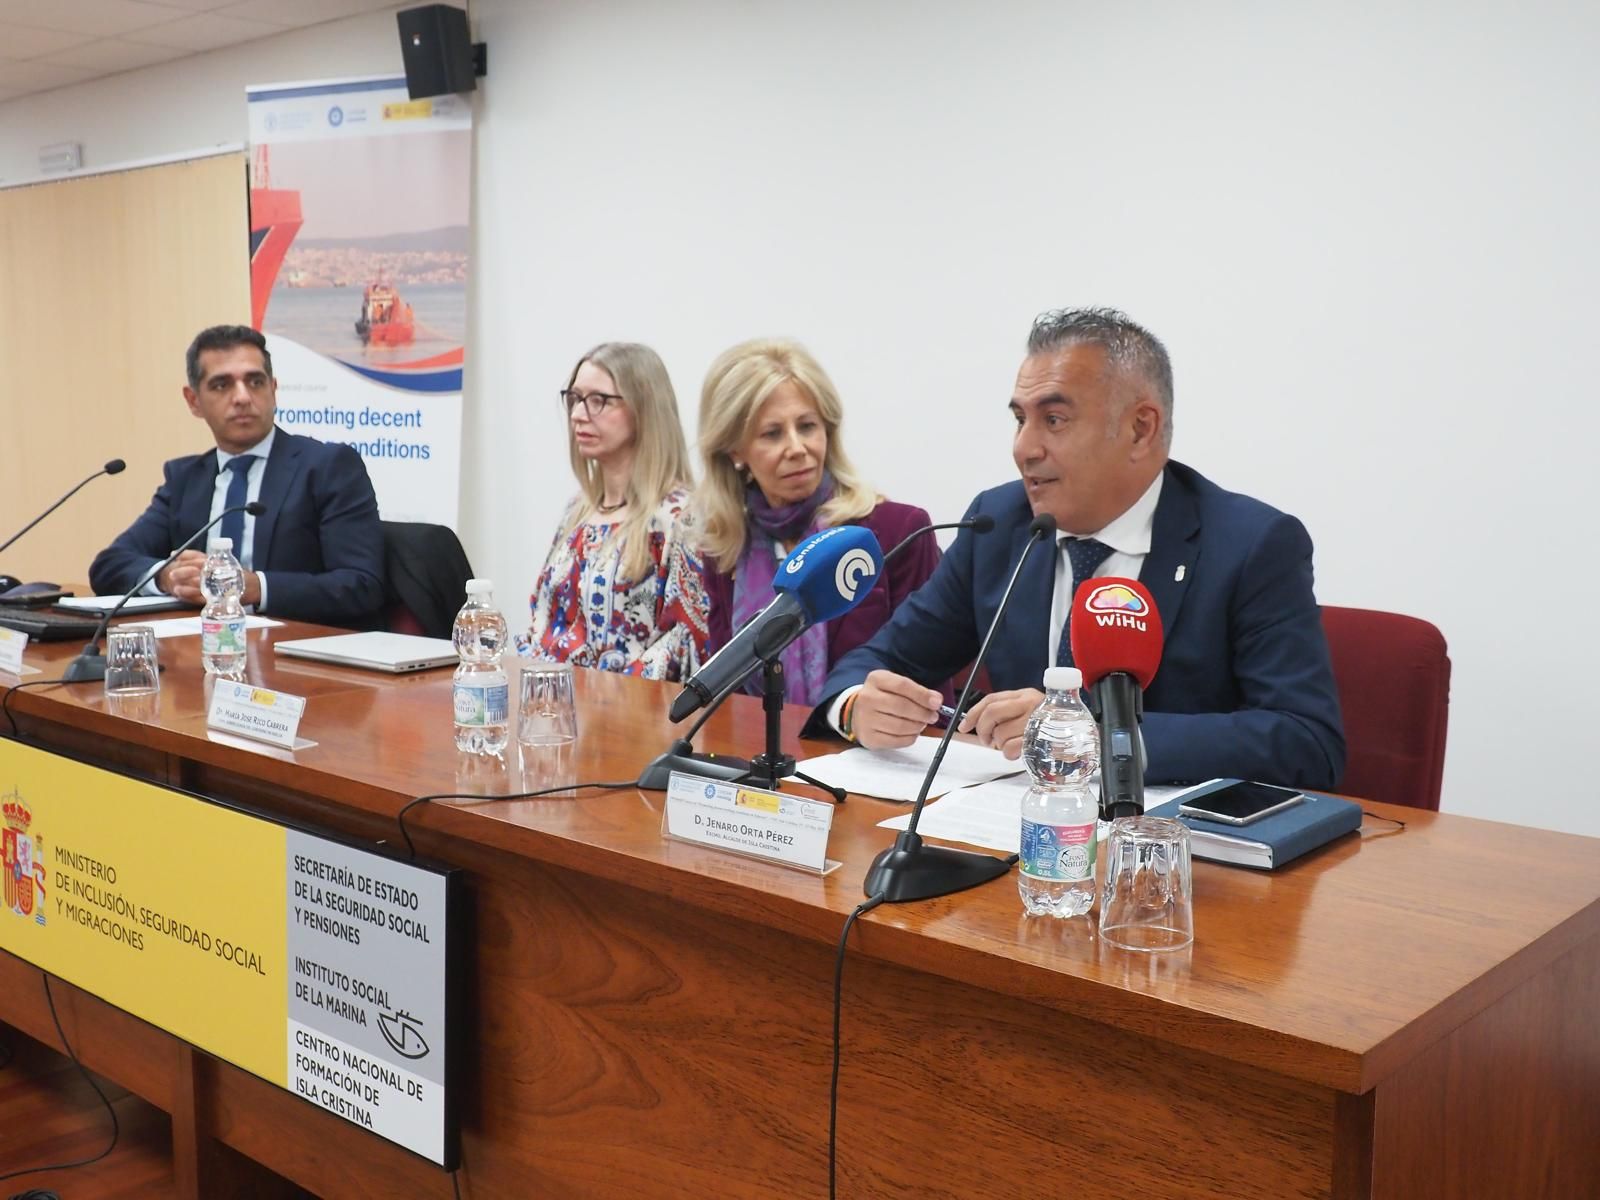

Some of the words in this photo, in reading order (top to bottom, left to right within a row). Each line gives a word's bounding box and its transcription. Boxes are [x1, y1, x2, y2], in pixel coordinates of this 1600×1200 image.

[358, 406, 422, 428] decent
[1095, 613, 1147, 632] WiHu
[267, 719, 289, 732] CABRERA
[694, 814, 704, 826] D.
[706, 816, 738, 833] JENARO
[740, 824, 764, 839] ORTA
[766, 829, 794, 846] PÉREZ
[55, 845, 117, 885] MINISTERIO
[294, 855, 355, 890] SECRETARÍA
[358, 874, 372, 895] DE
[375, 880, 419, 911] ESTADO
[1060, 859, 1088, 869] Natura
[55, 871, 71, 893] DE
[72, 878, 138, 924] INCLUSIÓN,
[139, 906, 212, 952] SEGURIDAD
[215, 938, 267, 976] SOCIAL
[55, 896, 63, 916] Y
[66, 901, 144, 951] MIGRACIONES
[294, 880, 308, 900] DE
[310, 885, 323, 906] LA
[325, 891, 386, 927] SEGURIDAD
[388, 913, 430, 944] SOCIAL
[294, 906, 302, 923] Y
[303, 910, 360, 945] PENSIONES
[295, 956, 350, 992] INSTITUTO
[352, 979, 392, 1010] SOCIAL
[295, 981, 309, 1002] DE
[311, 987, 324, 1009] LA
[326, 993, 367, 1028] MARINA
[295, 1030, 340, 1062] CENTRO
[343, 1050, 404, 1093] NACIONAL
[407, 1079, 423, 1102] DE
[296, 1053, 361, 1098] FORMACIÓN
[364, 1085, 380, 1107] DE
[296, 1076, 319, 1101] ISLA
[321, 1090, 373, 1129] CRISTINA
